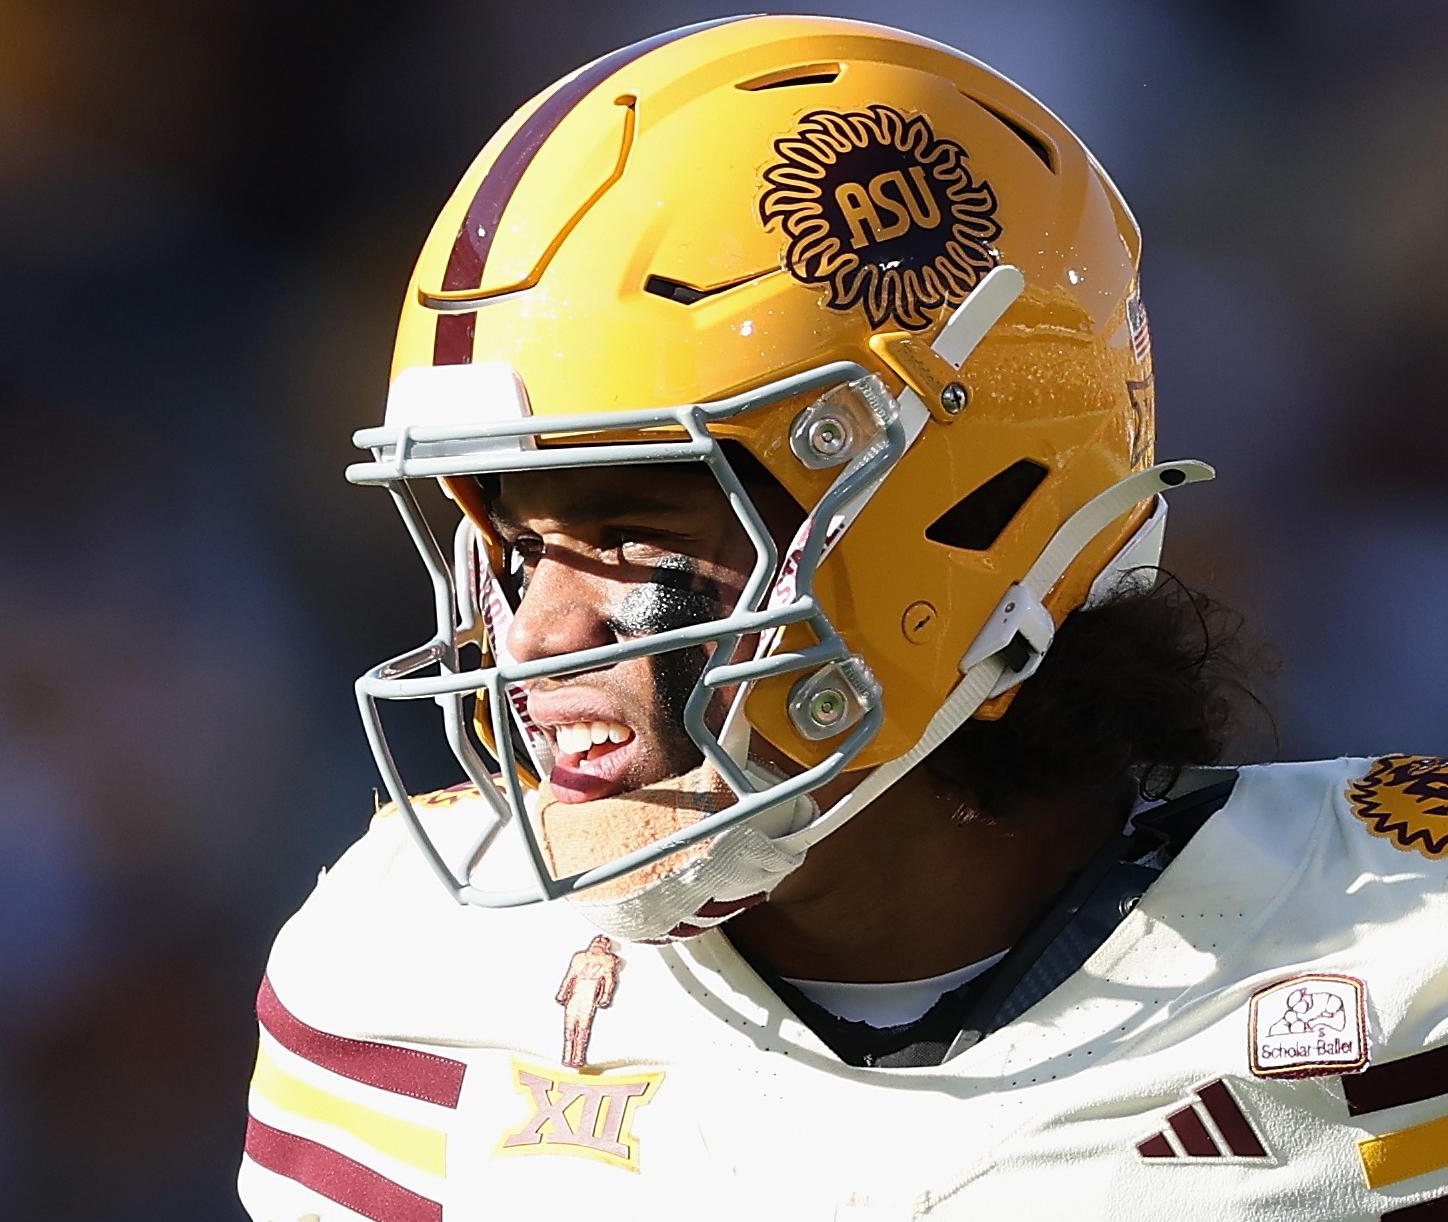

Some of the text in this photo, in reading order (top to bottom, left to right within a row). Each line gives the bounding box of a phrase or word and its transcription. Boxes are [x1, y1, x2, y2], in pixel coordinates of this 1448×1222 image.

[834, 165, 942, 250] ASU
[1261, 1038, 1353, 1060] Scholar Baller
[502, 1068, 651, 1161] XII
